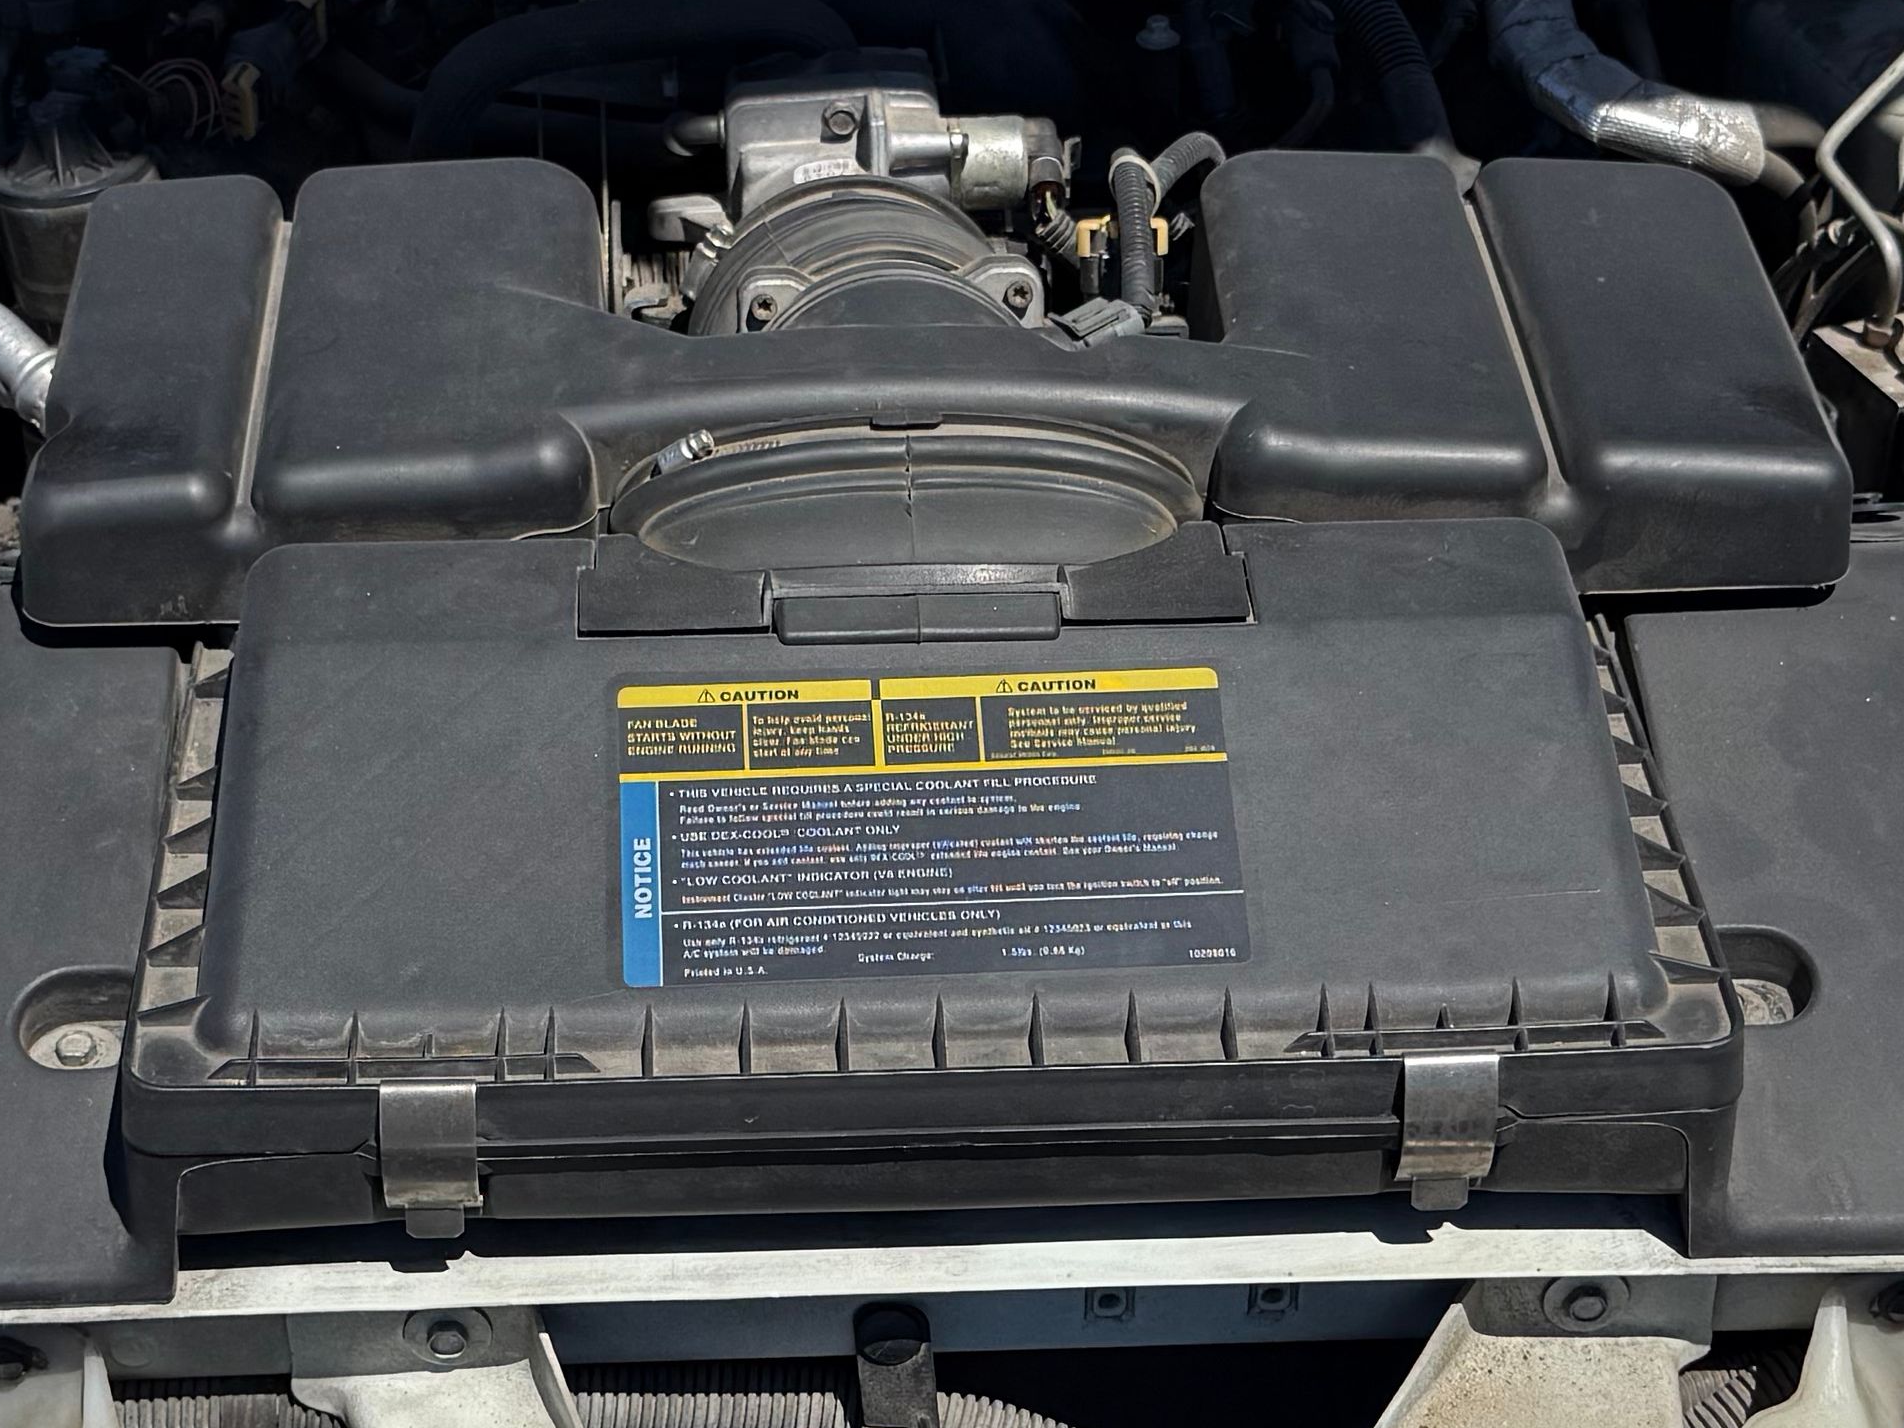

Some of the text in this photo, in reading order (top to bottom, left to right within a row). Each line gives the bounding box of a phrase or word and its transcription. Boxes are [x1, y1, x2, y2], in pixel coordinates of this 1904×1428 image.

[1017, 679, 1097, 692] CAUTION
[720, 690, 799, 702] CAUTION
[1008, 706, 1046, 717] System
[1078, 703, 1123, 713] serviced
[1141, 701, 1187, 713] qualified
[628, 719, 697, 730] FAN BLADE
[767, 715, 789, 726] help
[793, 714, 822, 723] avoid
[627, 730, 736, 743] STARTS WITHOUT
[789, 726, 816, 736] keep
[1116, 725, 1162, 735] personal
[887, 731, 964, 743] UNDER HIGH
[1010, 738, 1073, 749] See Service
[627, 743, 736, 756] ENGINE RUNNING
[888, 743, 955, 754] PRESSURE
[678, 775, 1096, 799] THIS VEHICLE REQUIRES A SPECIAL COOLANT FILL PROCEDURE
[680, 804, 705, 813] Read
[874, 798, 907, 809] adding
[680, 815, 714, 824] Failure
[976, 805, 1015, 816] damage
[680, 824, 900, 842] USE COOLANT ONLY
[633, 837, 652, 918] NOTICE
[681, 876, 718, 886] "LOW
[722, 874, 792, 885] COOLANT"
[797, 871, 869, 882] INDICATOR
[897, 868, 953, 880] ENGINE)
[682, 909, 1001, 930] R-134a (FOR AIR CONDITIONED VEHICLES ONLY)
[684, 967, 720, 978] Printed
